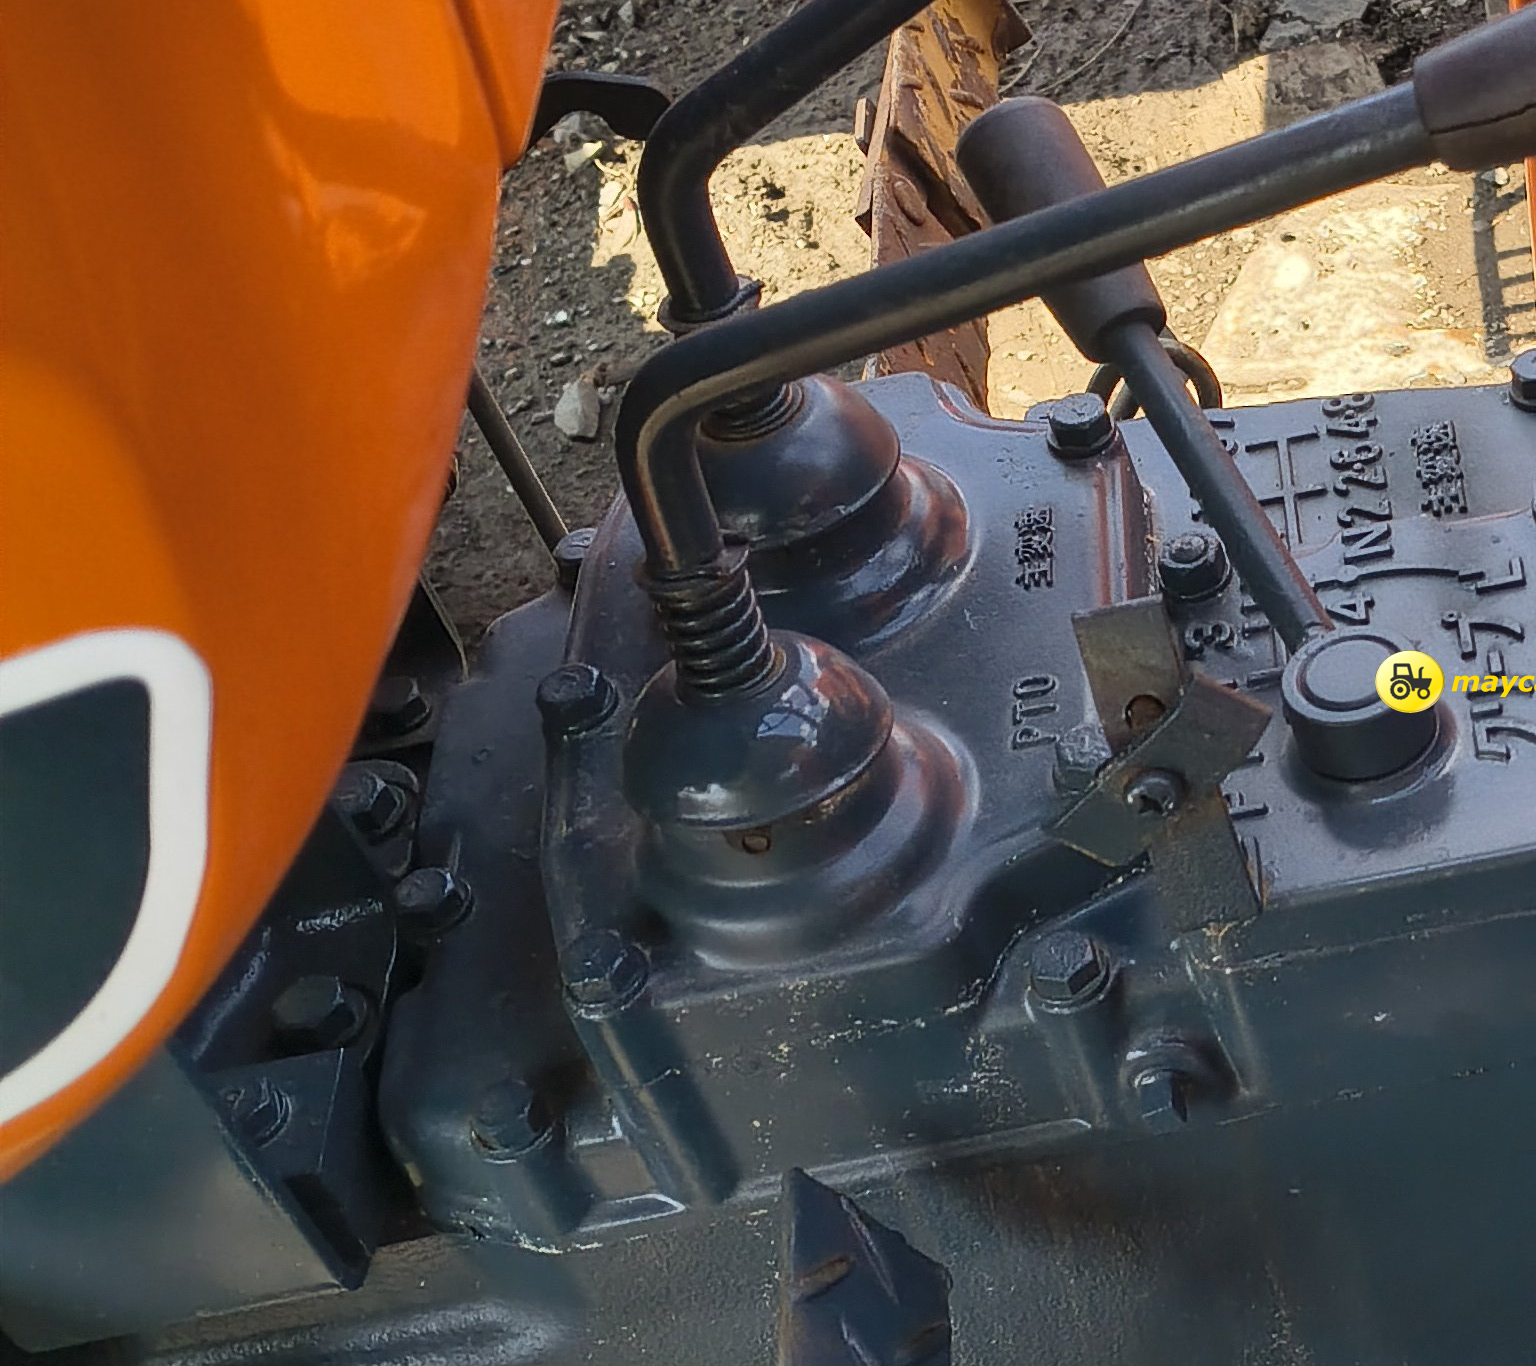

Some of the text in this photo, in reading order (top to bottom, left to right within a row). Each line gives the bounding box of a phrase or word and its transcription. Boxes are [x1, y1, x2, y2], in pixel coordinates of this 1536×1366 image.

[1014, 506, 1055, 590] 主変速
[1011, 675, 1059, 751] PTO
